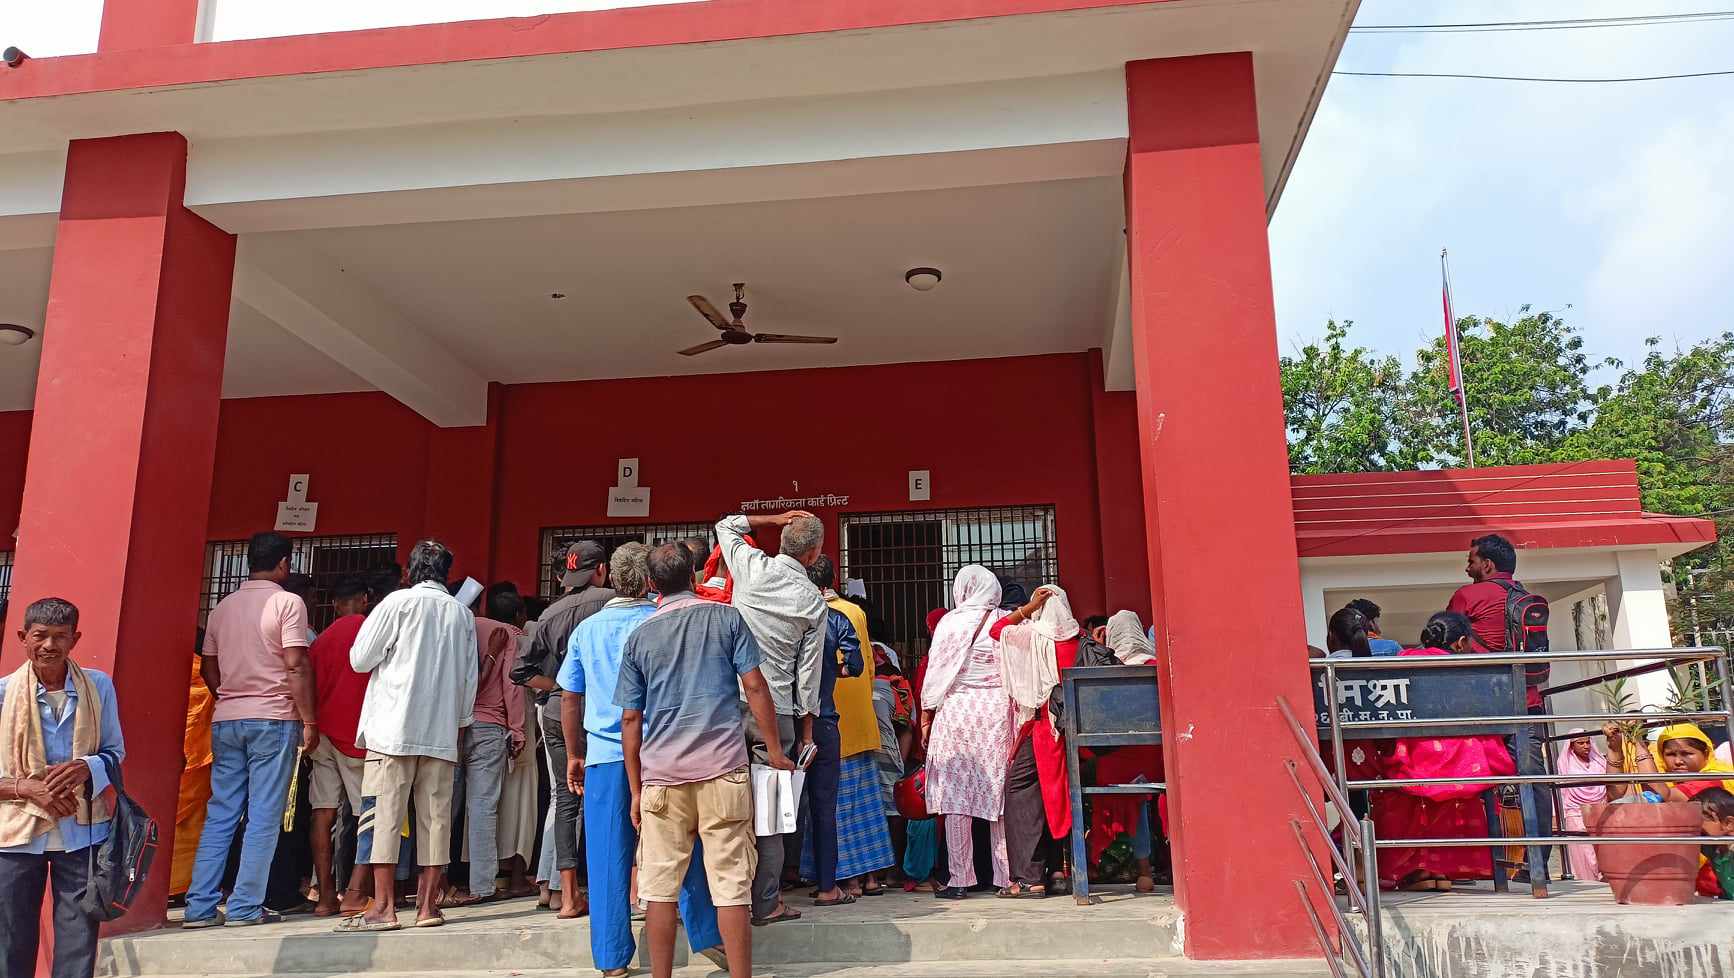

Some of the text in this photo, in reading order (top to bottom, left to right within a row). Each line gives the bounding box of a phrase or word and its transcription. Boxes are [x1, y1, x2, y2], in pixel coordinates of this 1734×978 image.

[623, 466, 633, 478] D
[294, 481, 303, 492] C
[915, 478, 923, 490] E
[760, 496, 806, 510] नागरिकता
[807, 494, 825, 507] कार्ड
